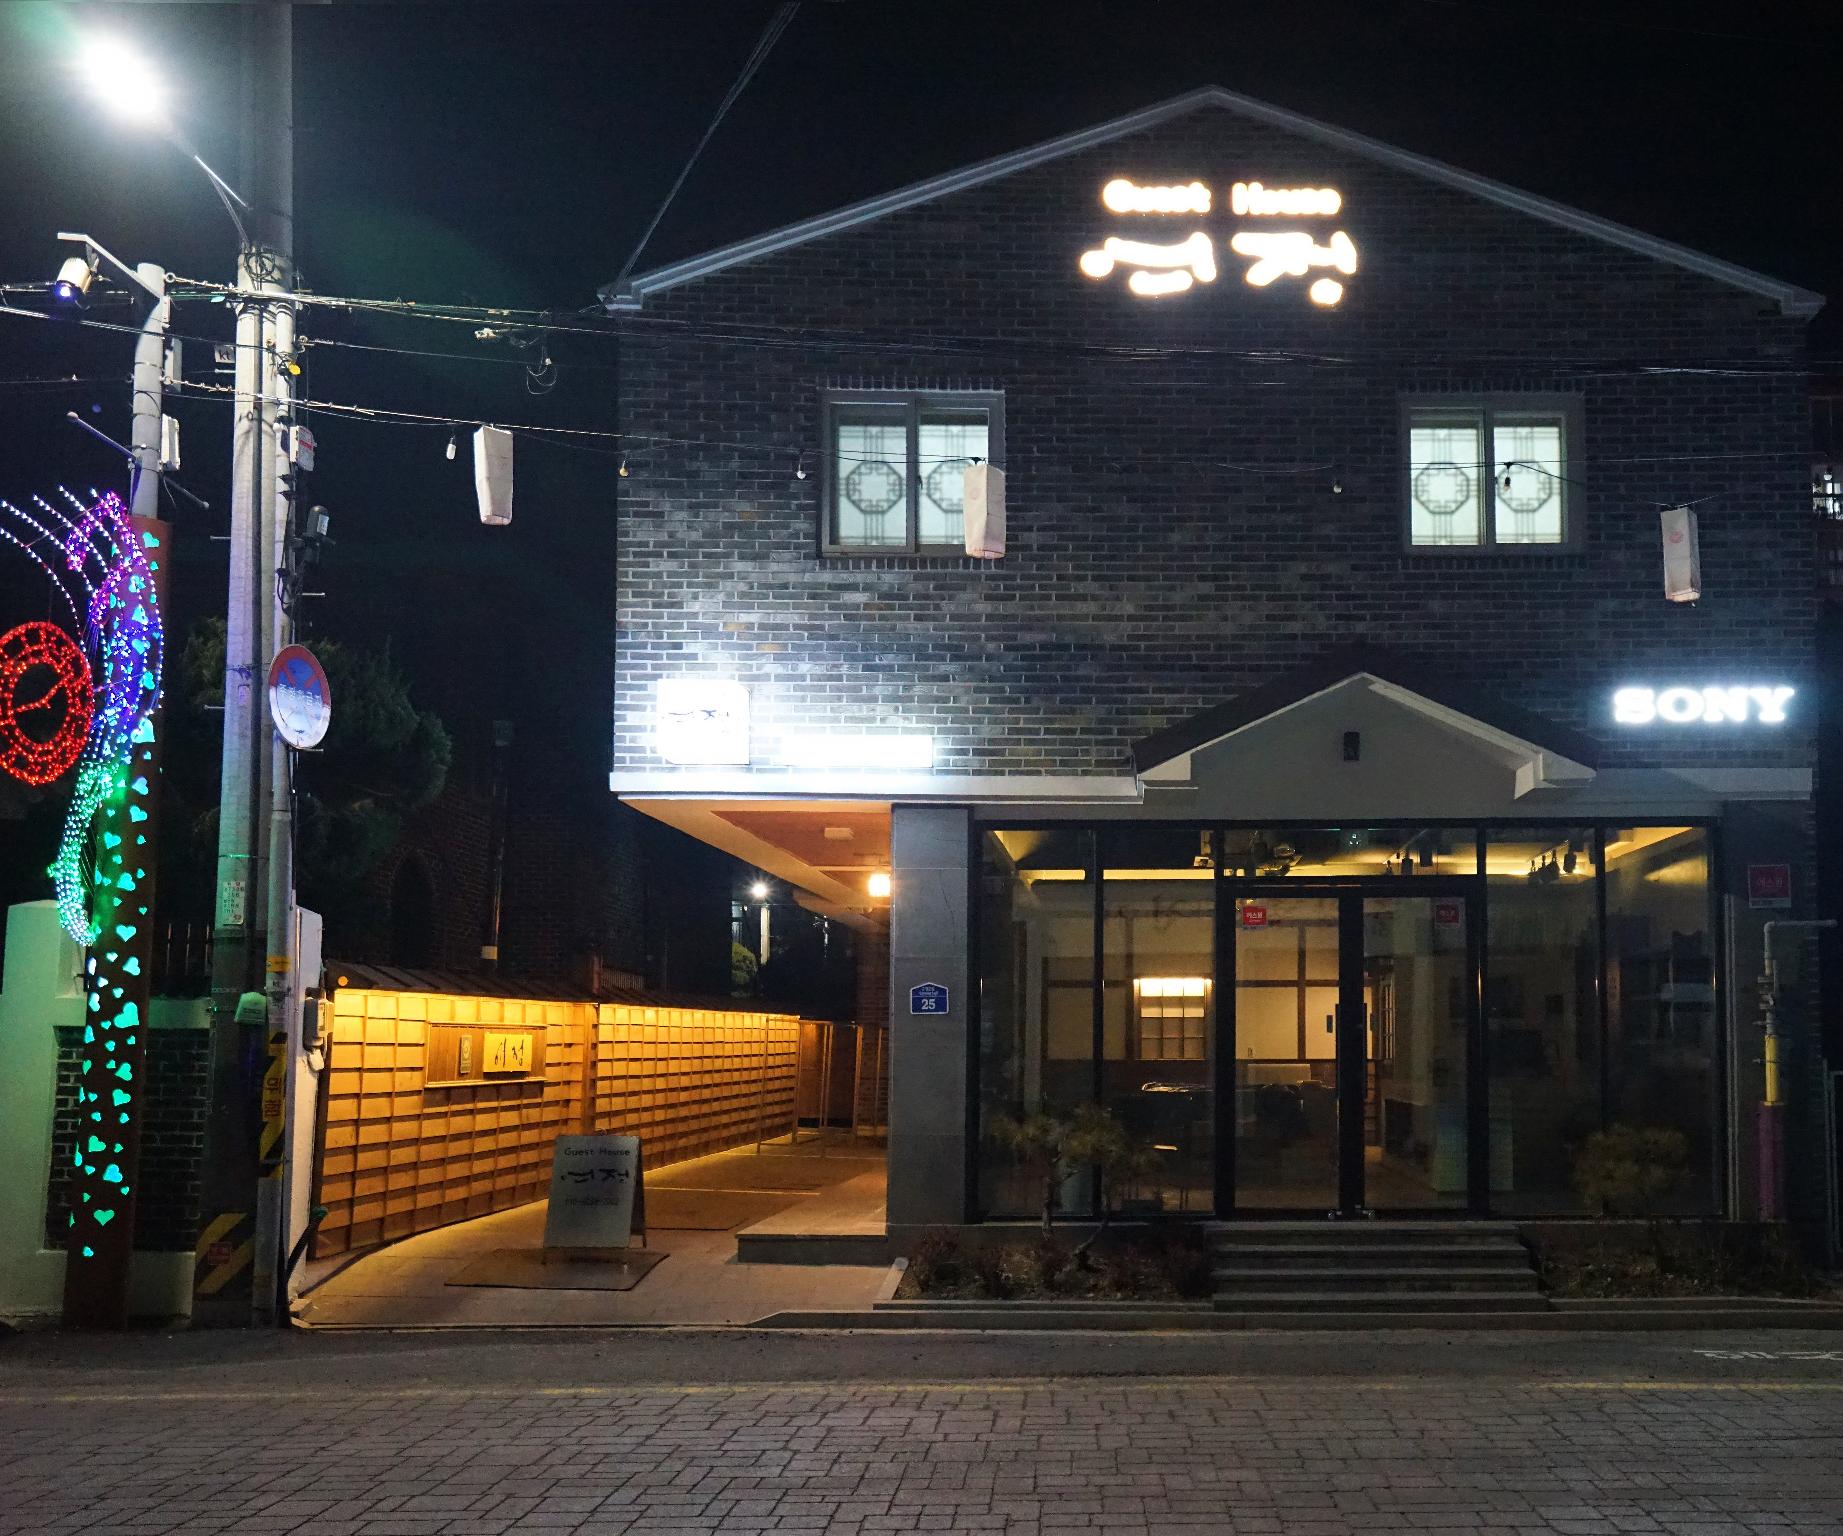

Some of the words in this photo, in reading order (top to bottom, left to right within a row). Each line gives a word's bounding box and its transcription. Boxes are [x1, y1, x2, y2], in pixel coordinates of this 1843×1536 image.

[219, 350, 231, 361] kt
[1613, 687, 1796, 723] SONY
[921, 998, 936, 1010] 25
[564, 1147, 594, 1157] Guest
[599, 1147, 631, 1156] House
